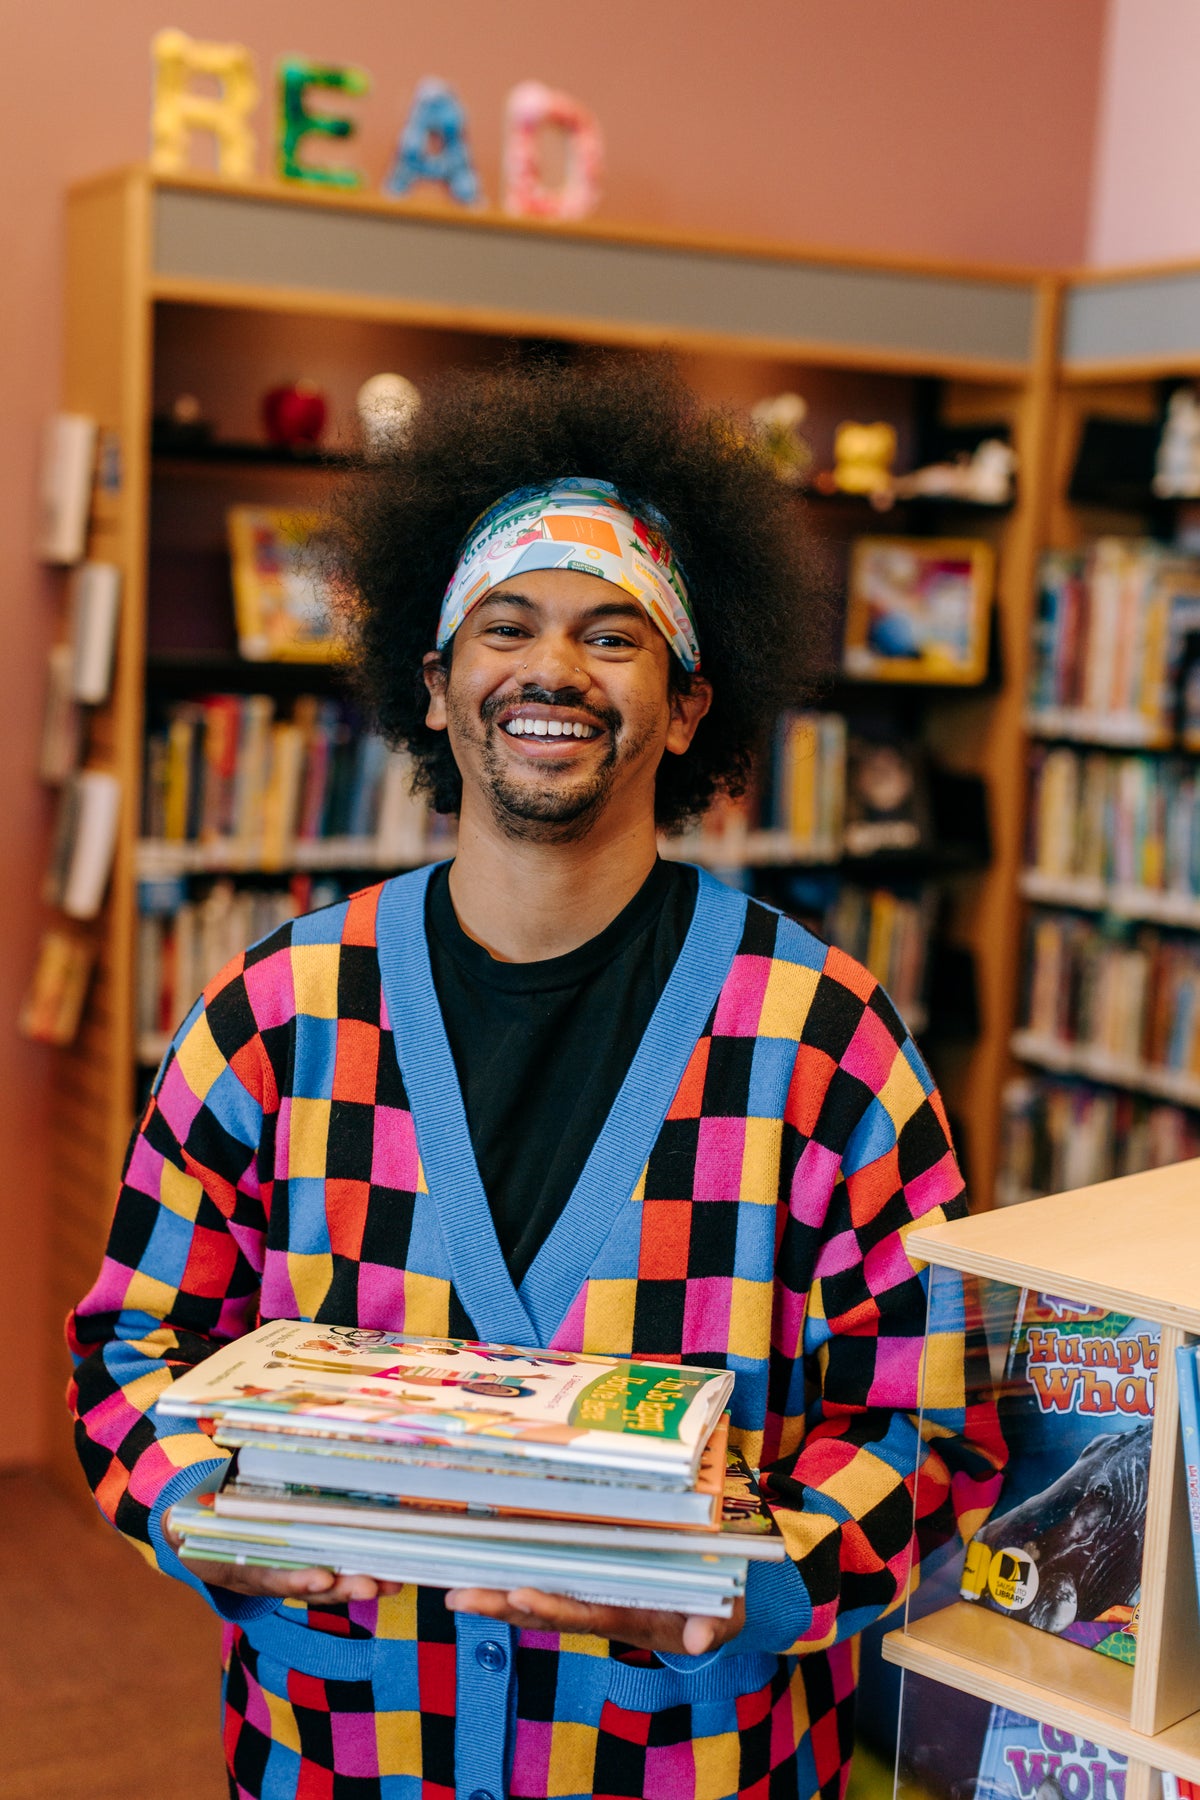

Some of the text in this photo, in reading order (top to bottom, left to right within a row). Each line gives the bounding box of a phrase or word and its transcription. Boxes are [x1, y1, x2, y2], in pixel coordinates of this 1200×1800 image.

[150, 27, 605, 220] READ
[646, 1389, 683, 1402] So
[580, 1399, 620, 1421] Here
[621, 1400, 676, 1432] Happy
[995, 1588, 1025, 1605] LIBRARY
[996, 1581, 1027, 1597] SAUSALITO
